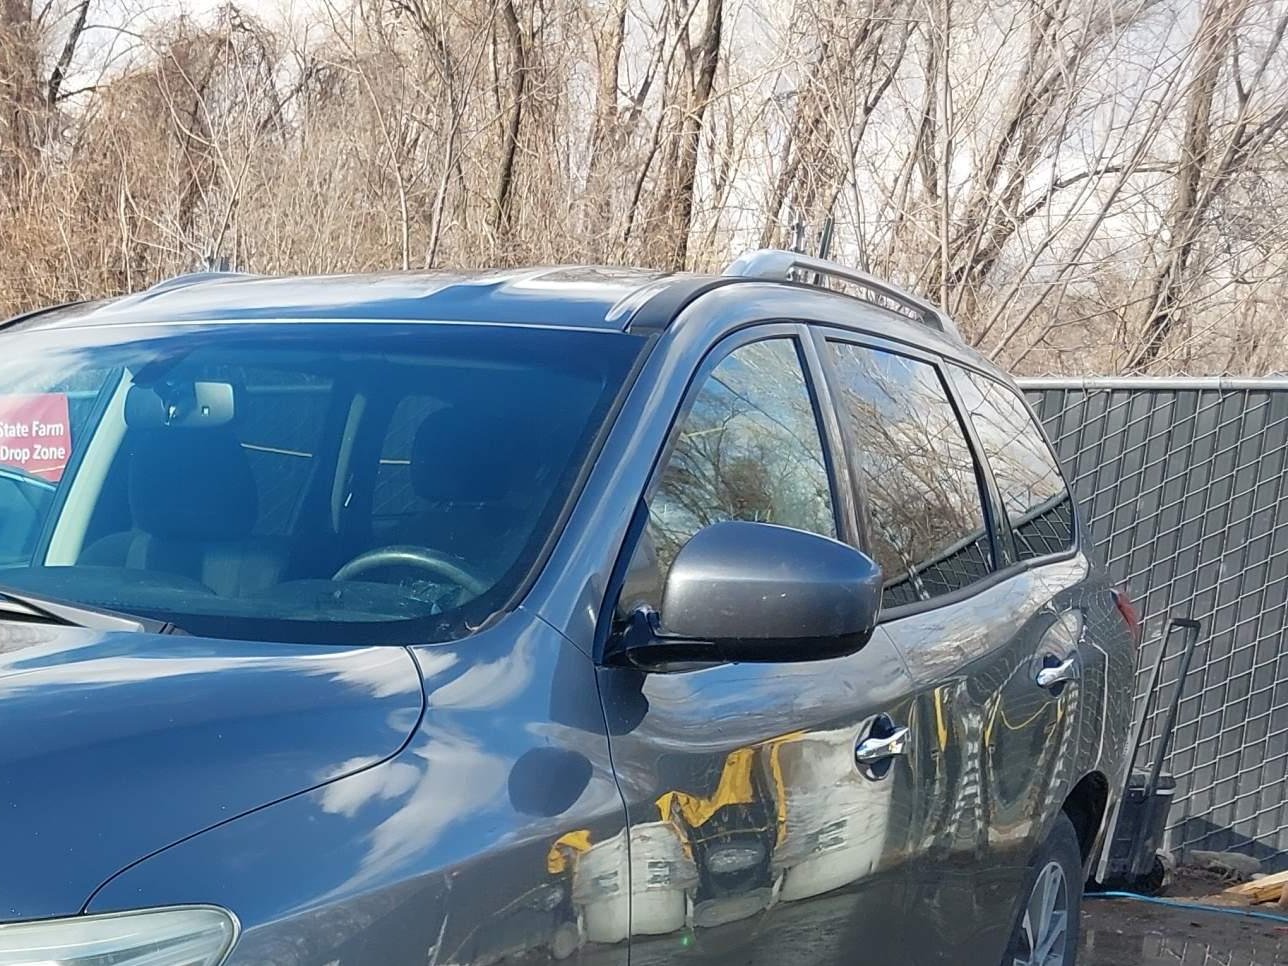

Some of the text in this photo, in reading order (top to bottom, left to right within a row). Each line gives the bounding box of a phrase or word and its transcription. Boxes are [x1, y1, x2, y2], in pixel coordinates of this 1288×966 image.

[32, 420, 64, 437] Farm
[0, 444, 66, 464] Drop Zone
